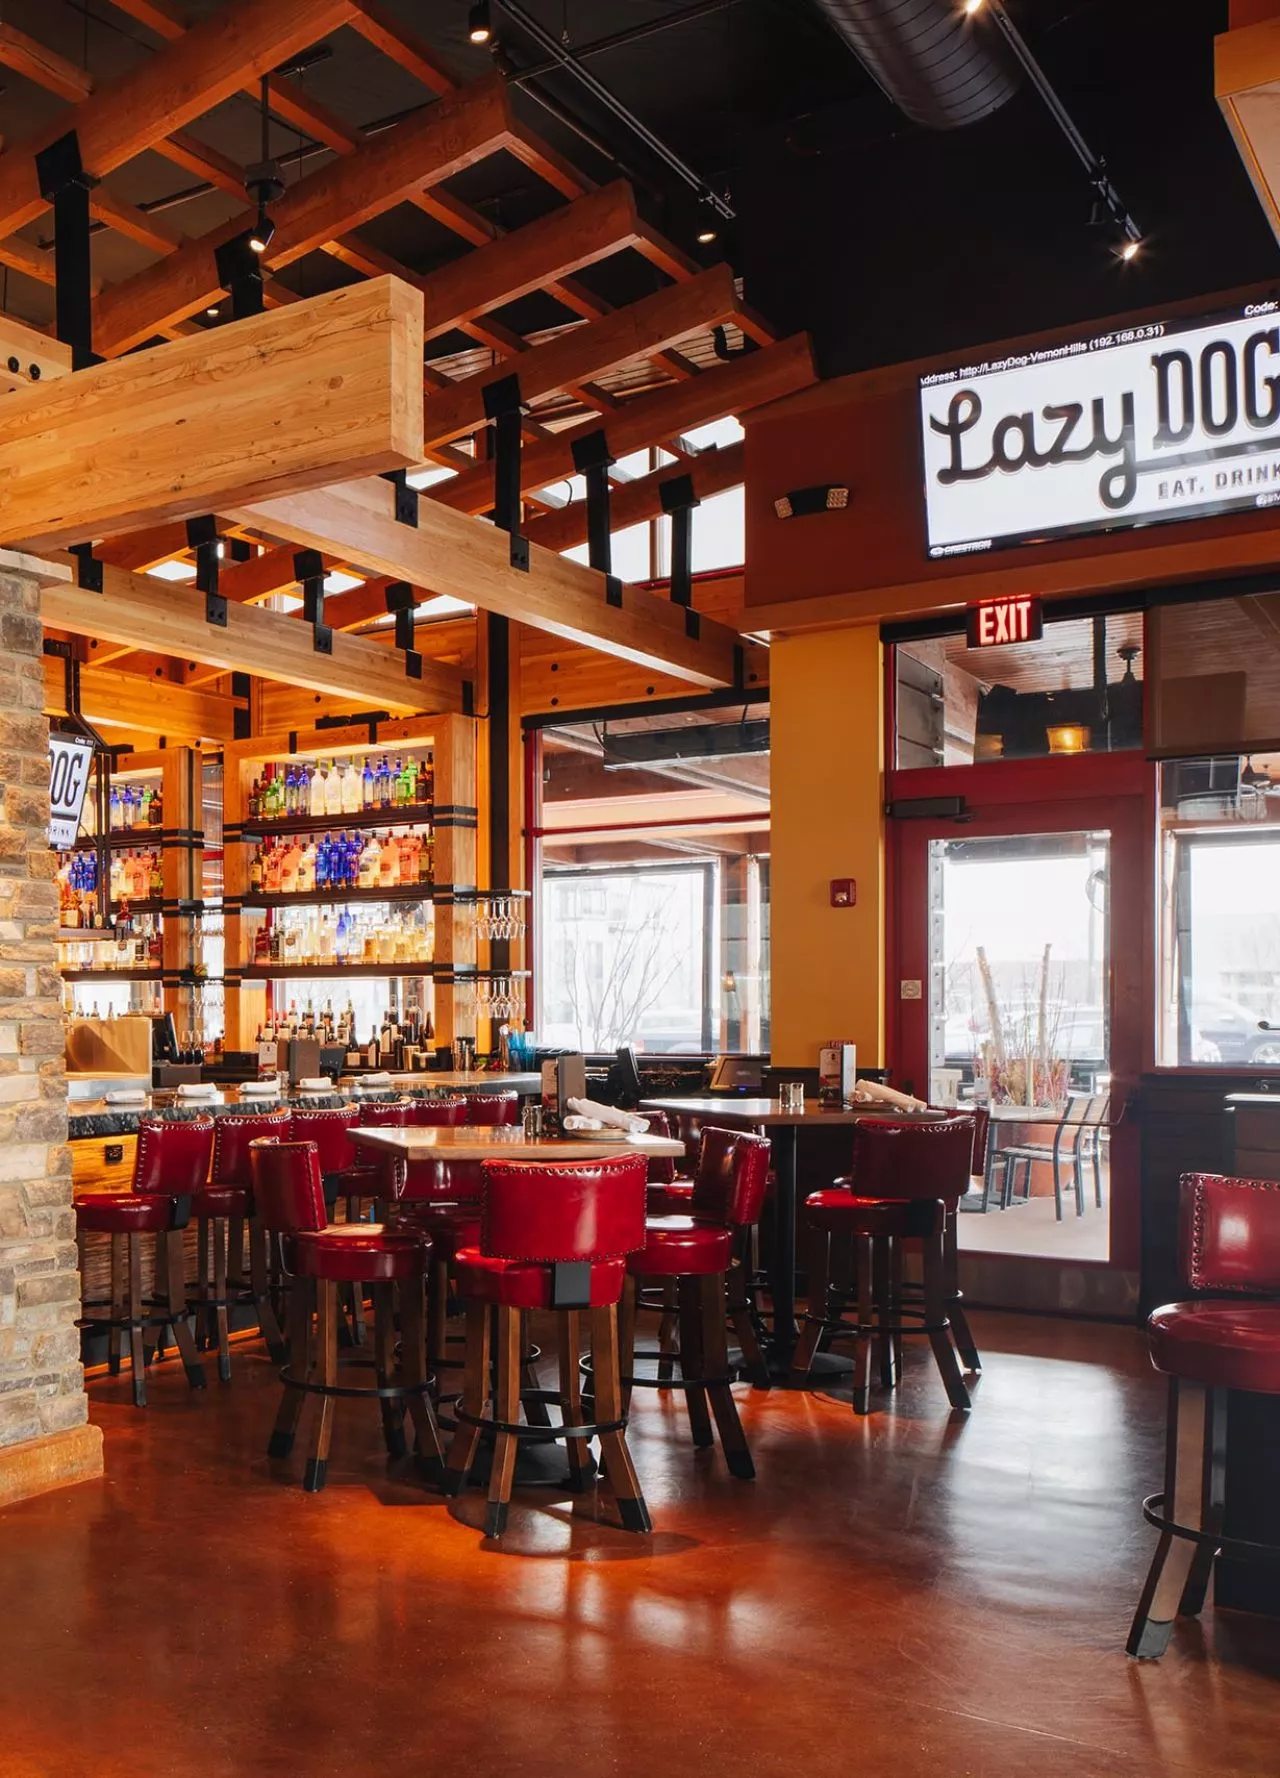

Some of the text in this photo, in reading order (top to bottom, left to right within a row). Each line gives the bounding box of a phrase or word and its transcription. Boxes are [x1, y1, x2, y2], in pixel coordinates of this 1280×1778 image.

[1089, 325, 1165, 350] (192.168.0.31)
[930, 325, 1280, 510] Lazy DOG
[980, 601, 1031, 645] EXIT
